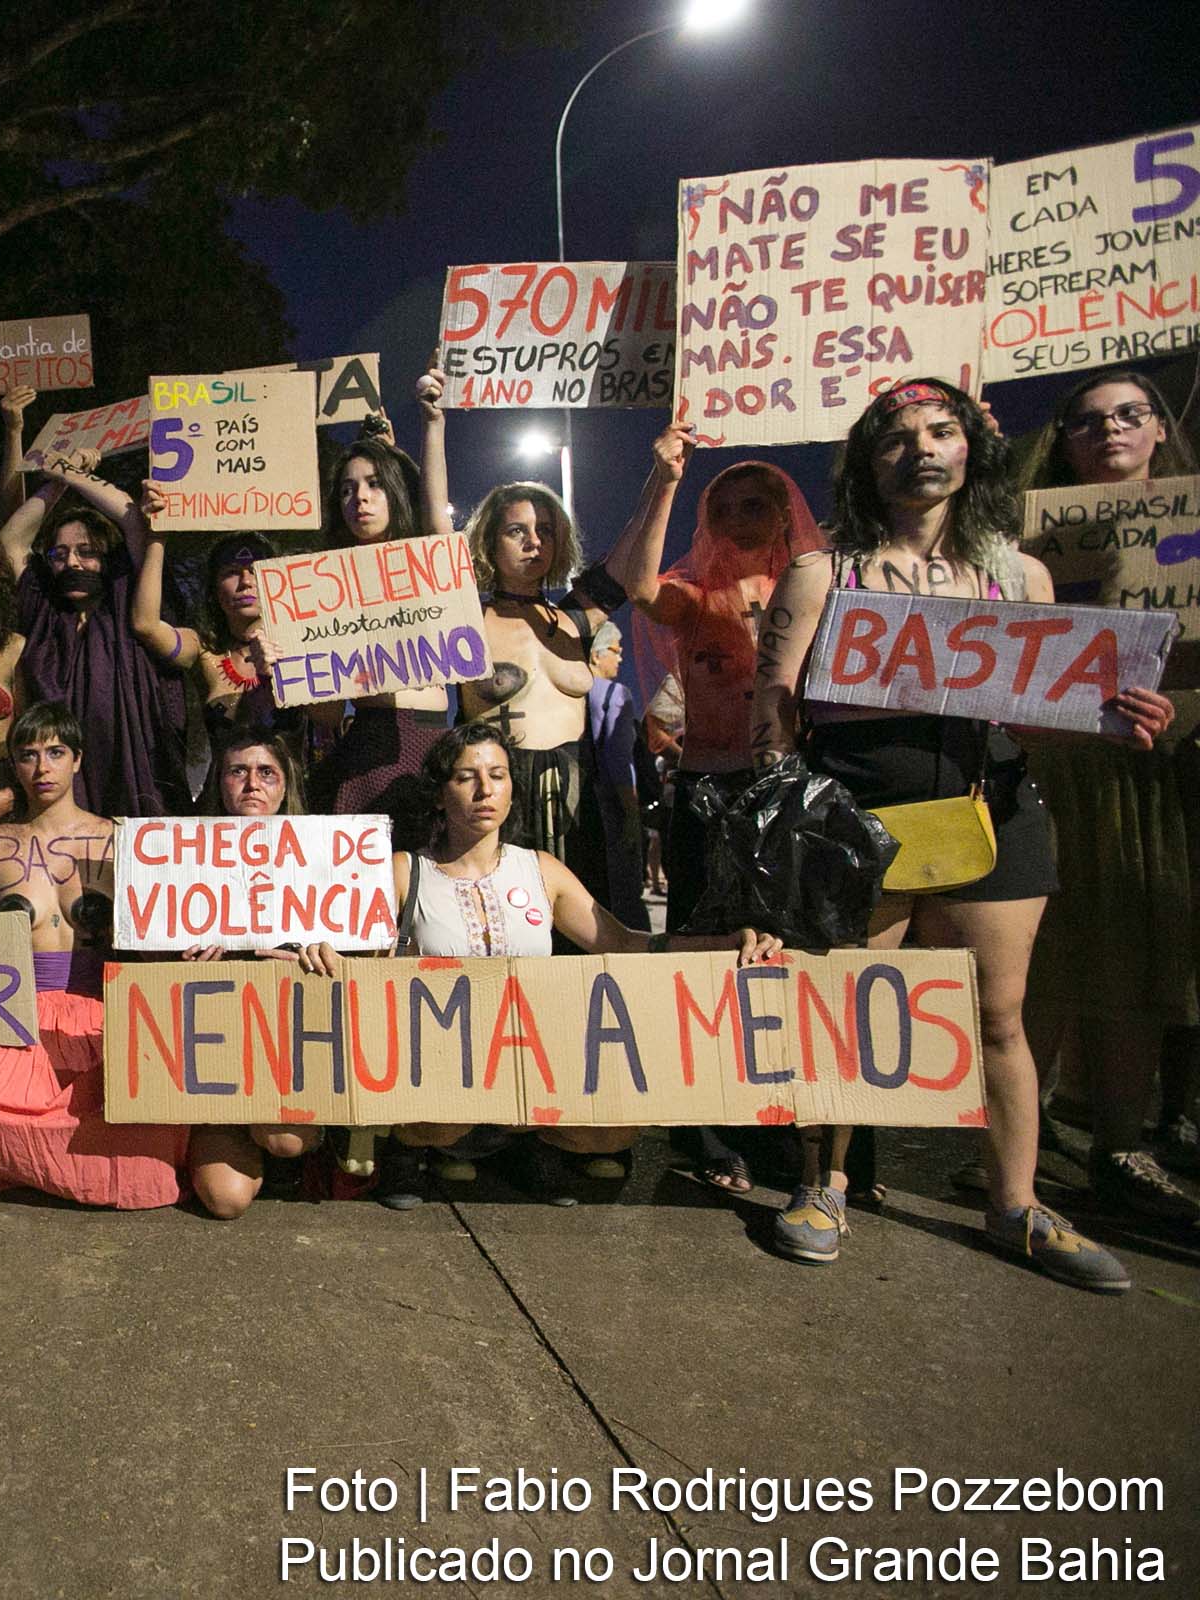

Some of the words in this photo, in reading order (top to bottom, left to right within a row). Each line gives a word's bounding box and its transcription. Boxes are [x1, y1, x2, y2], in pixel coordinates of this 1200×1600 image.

[1026, 166, 1077, 196] EM
[719, 172, 820, 234] NÃO
[859, 178, 929, 216] ME
[1010, 195, 1098, 232] CADA
[687, 232, 807, 285] MATE
[830, 223, 887, 262] SE
[914, 226, 969, 261] EU
[987, 240, 1072, 277] HERES
[1002, 259, 1157, 305] SOFRERAM
[443, 264, 578, 342] 570
[681, 280, 778, 336] NÃO
[791, 277, 848, 315] TE
[63, 328, 87, 353] de
[444, 338, 620, 378] ESTUPROS
[812, 325, 913, 368] ESSA
[1013, 340, 1090, 373] SEUS
[552, 378, 585, 403] NO
[703, 377, 797, 418] DOR
[55, 399, 141, 436] SEM
[216, 414, 259, 436] PAÍS
[216, 438, 255, 452] COM
[216, 456, 266, 474] MAIS
[1041, 504, 1087, 531] NO
[1043, 535, 1063, 558] A
[1080, 525, 1157, 550] CADA
[301, 605, 447, 643] substantivo
[272, 624, 485, 702] FEMININO
[831, 608, 1120, 702] BASTA
[133, 820, 307, 868] CHEGA
[333, 827, 386, 867] DE
[128, 974, 557, 1099] NENHUMA
[583, 972, 648, 1095] A
[674, 963, 973, 1091] MENOS
